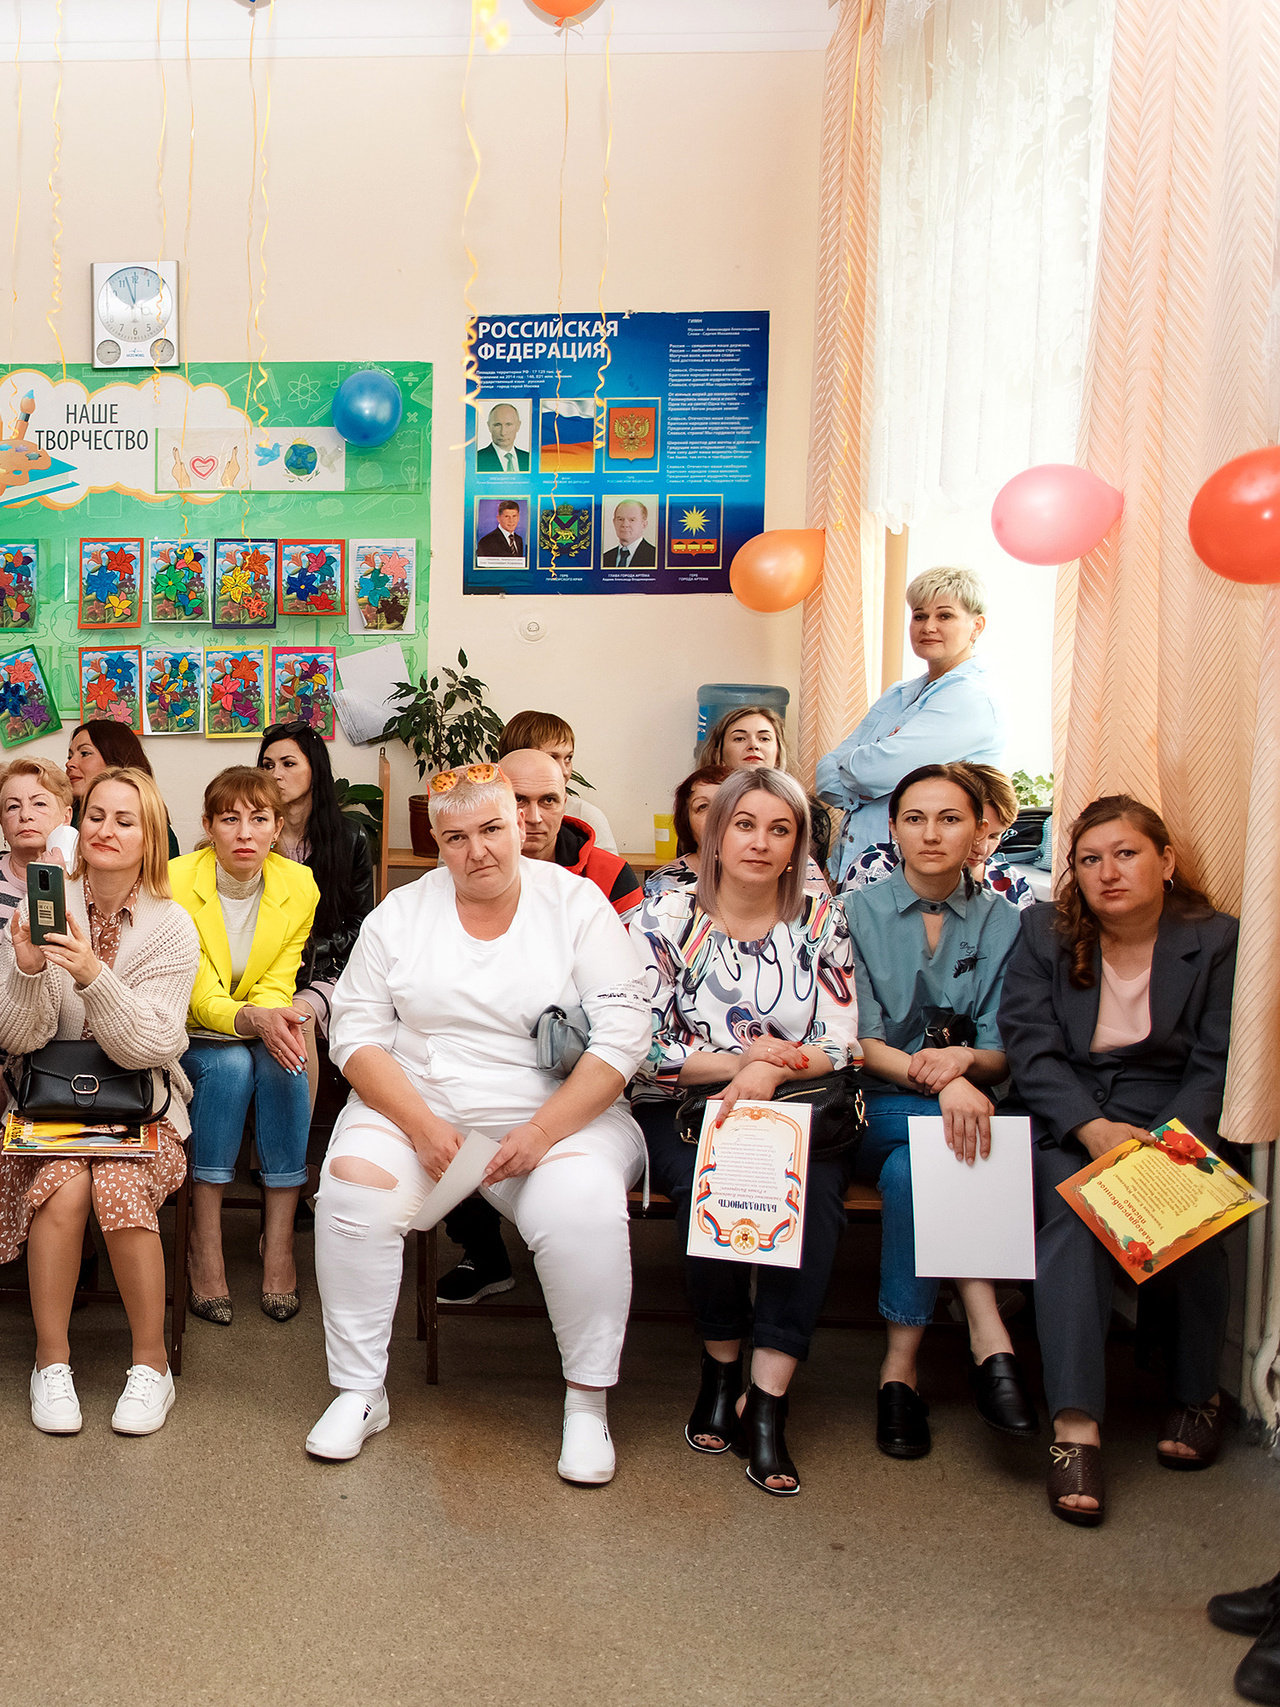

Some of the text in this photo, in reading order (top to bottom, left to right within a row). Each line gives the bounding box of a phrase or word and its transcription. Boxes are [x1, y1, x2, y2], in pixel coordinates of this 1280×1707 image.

[120, 324, 124, 332] 7
[133, 328, 138, 336] 6
[147, 324, 151, 332] 5
[478, 318, 618, 338] РОССИЙСКАЯ
[478, 342, 606, 363] ФЕДЕРАЦИЯ
[66, 404, 118, 424] НАШЕ
[35, 430, 148, 450] ТВОРЧЕСТВО
[718, 1198, 777, 1213] БЛАГОДАРНОСТЬ
[1097, 1181, 1155, 1246] Благодарственное
[1124, 1200, 1146, 1224] письмо
